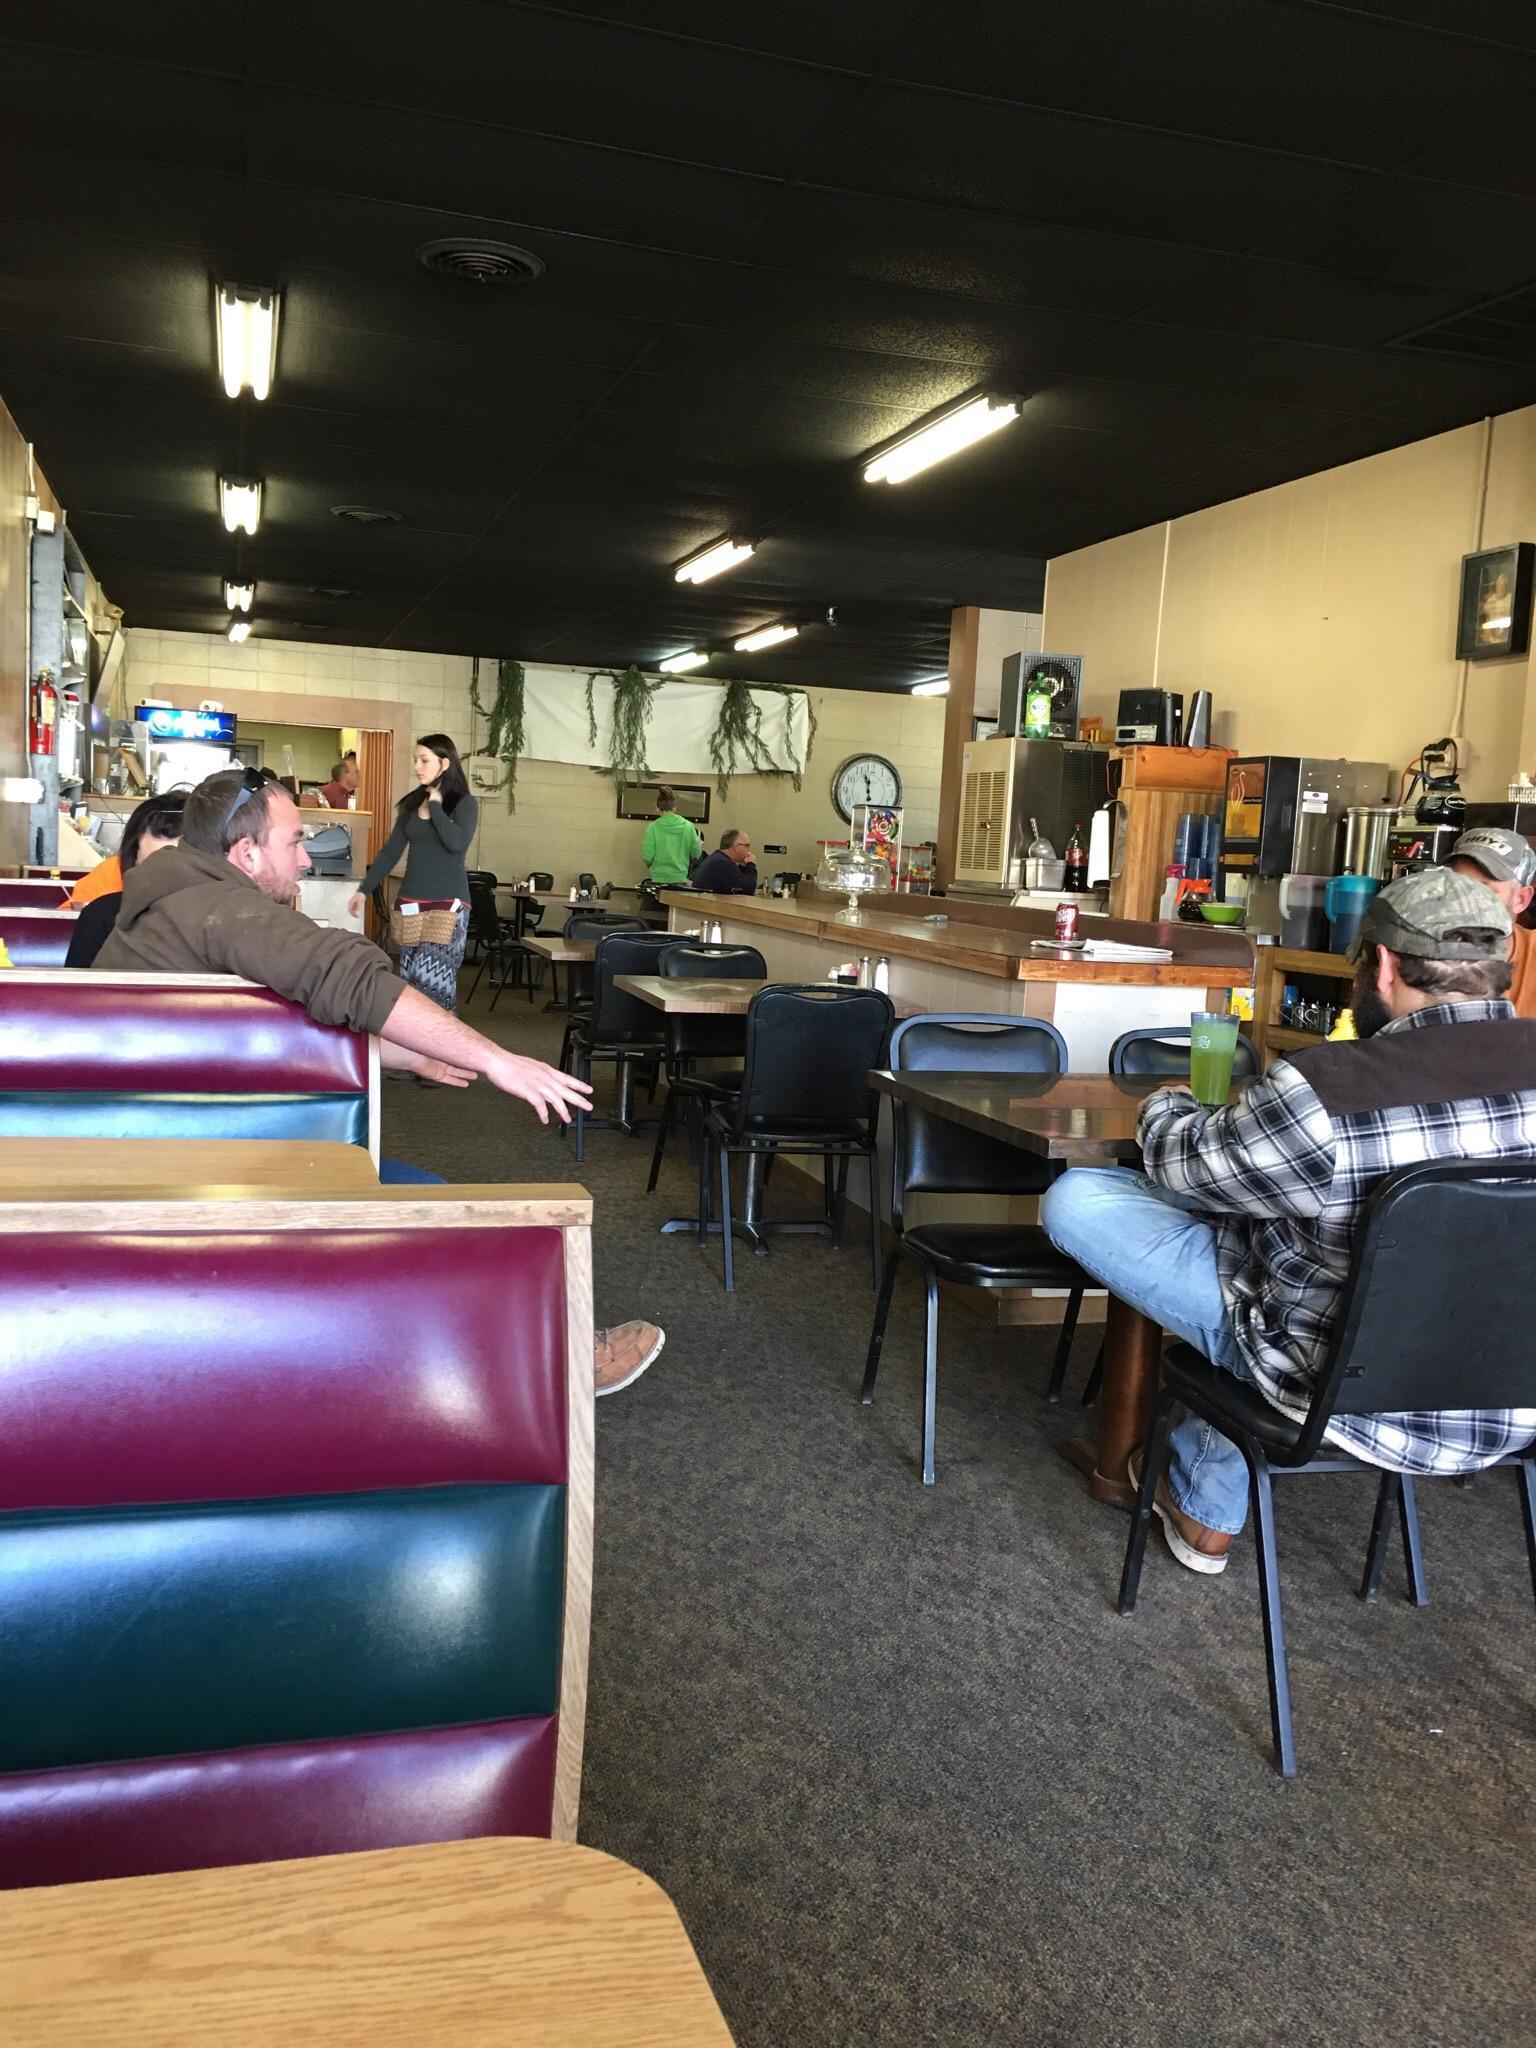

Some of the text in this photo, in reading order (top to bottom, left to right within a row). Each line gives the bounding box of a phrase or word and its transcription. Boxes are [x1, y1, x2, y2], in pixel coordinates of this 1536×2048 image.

[856, 767, 863, 775] 11
[866, 764, 876, 774] 12
[847, 775, 855, 783] 10
[846, 797, 851, 805] 8
